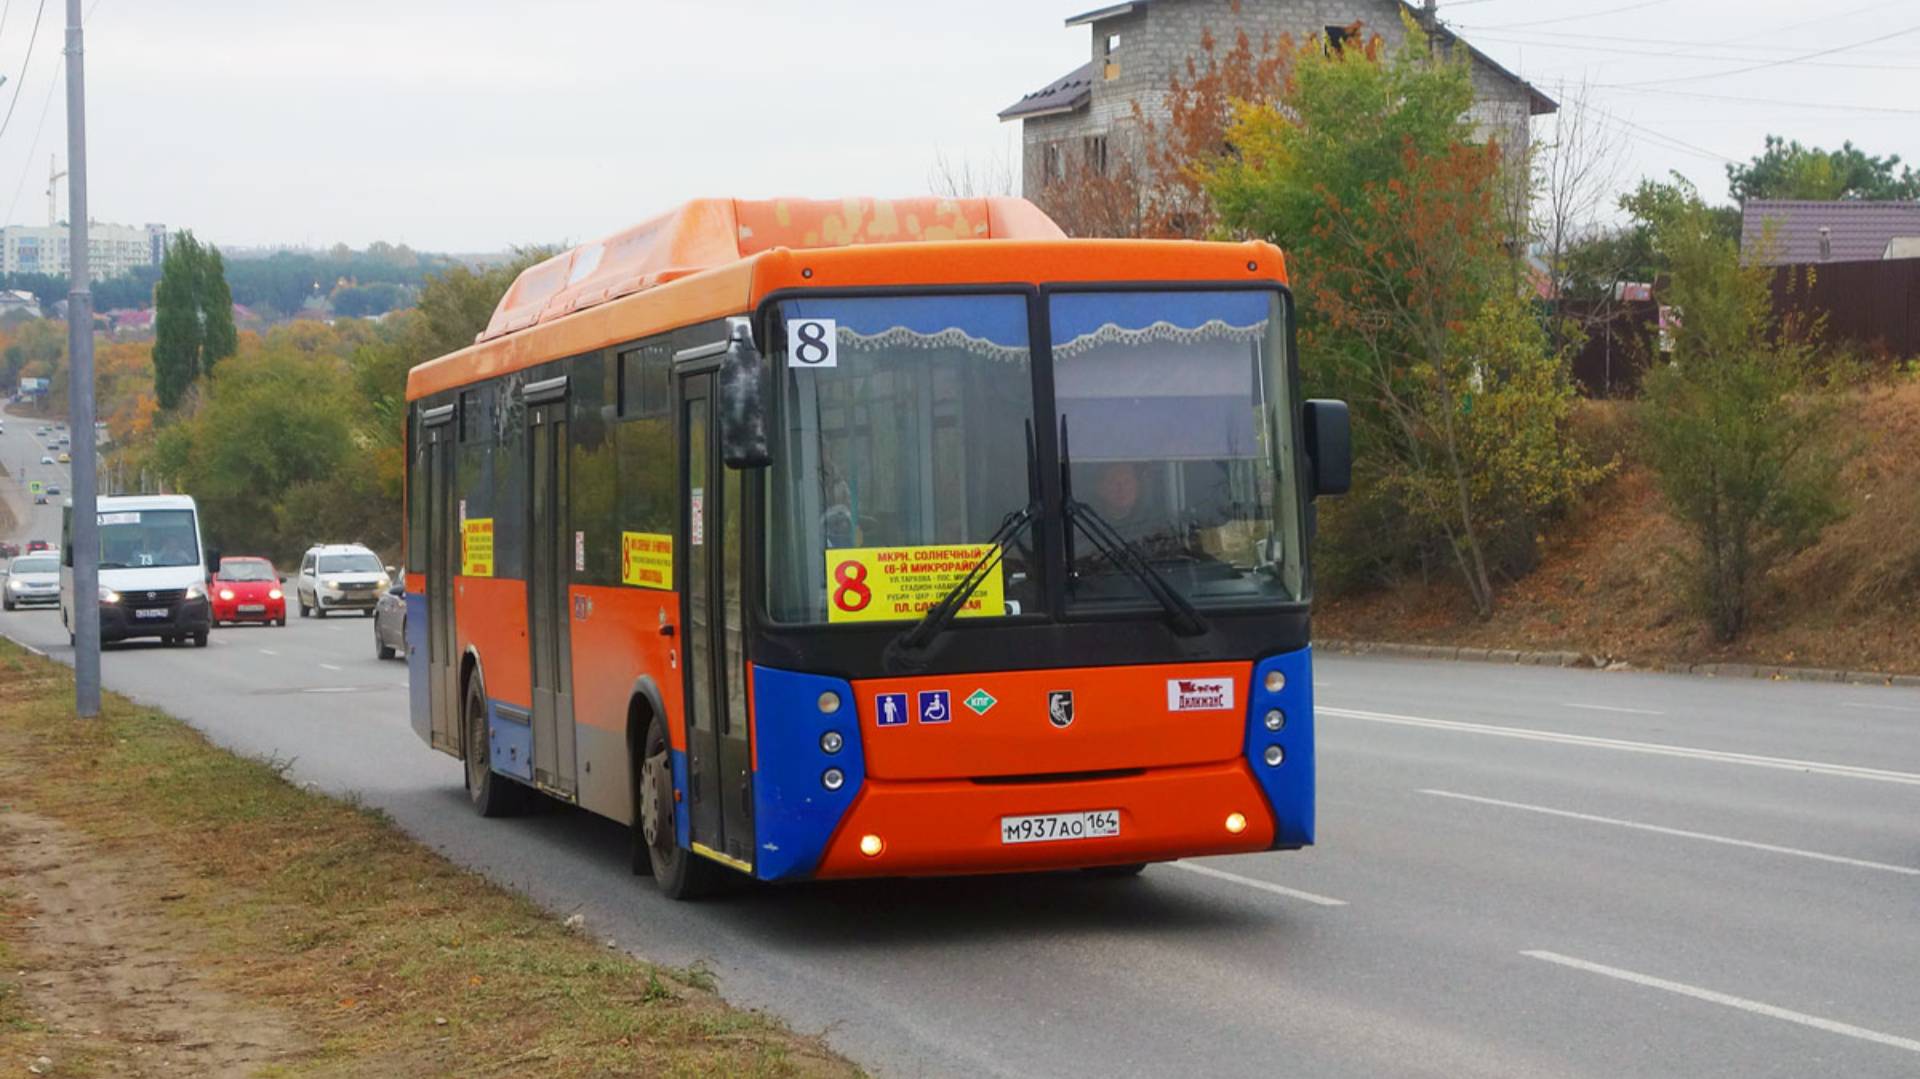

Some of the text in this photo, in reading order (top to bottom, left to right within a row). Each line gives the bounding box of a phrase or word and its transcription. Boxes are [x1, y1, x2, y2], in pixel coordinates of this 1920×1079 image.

[796, 322, 829, 364] 8
[878, 551, 912, 563] МКРН.
[833, 560, 872, 612] 8
[895, 602, 913, 613] ПЛ.
[1088, 813, 1117, 829] 164
